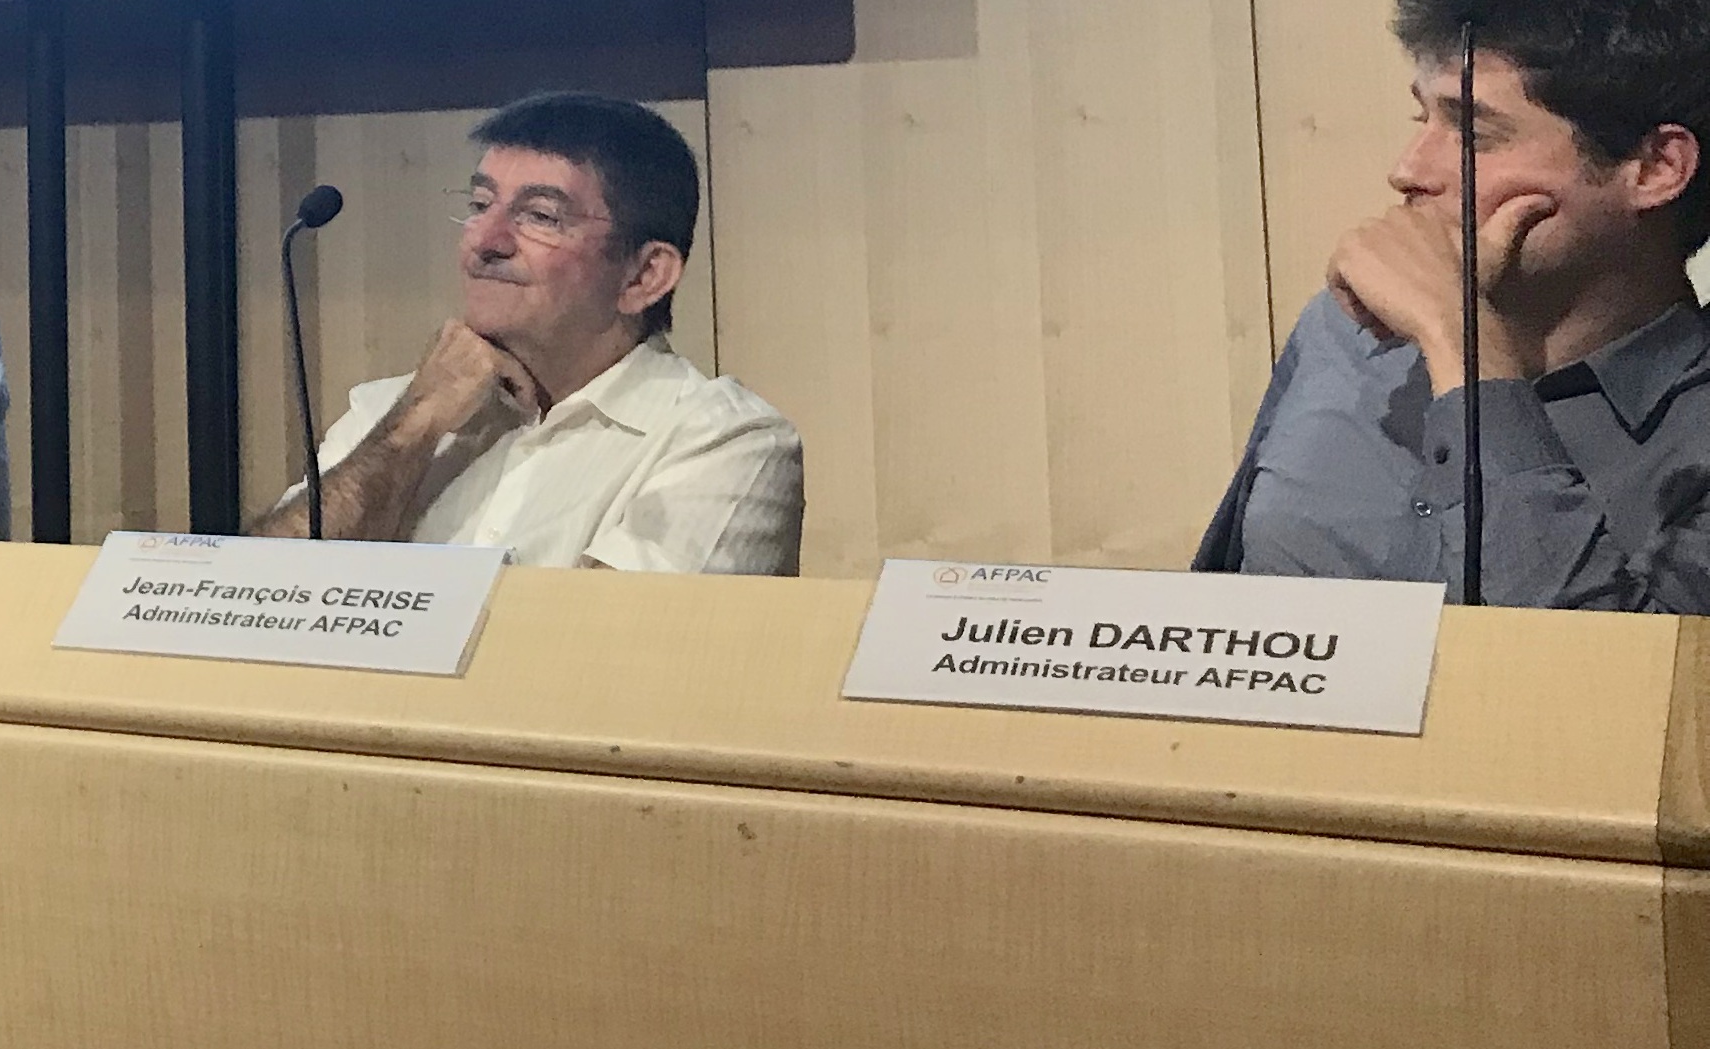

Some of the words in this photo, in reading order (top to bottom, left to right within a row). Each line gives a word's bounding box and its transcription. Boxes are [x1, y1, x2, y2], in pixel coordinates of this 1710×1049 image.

[164, 536, 226, 549] AFPAC
[969, 567, 1052, 583] AFPAC
[122, 576, 313, 606] Jean-François
[320, 587, 435, 612] CERISE
[122, 603, 307, 633] Administrateur
[308, 614, 405, 639] AFPAC
[941, 616, 1075, 648] Julien
[1088, 622, 1339, 662] DARTHOU
[931, 653, 1188, 687] Administrateur
[1194, 667, 1328, 696] AFPAC
